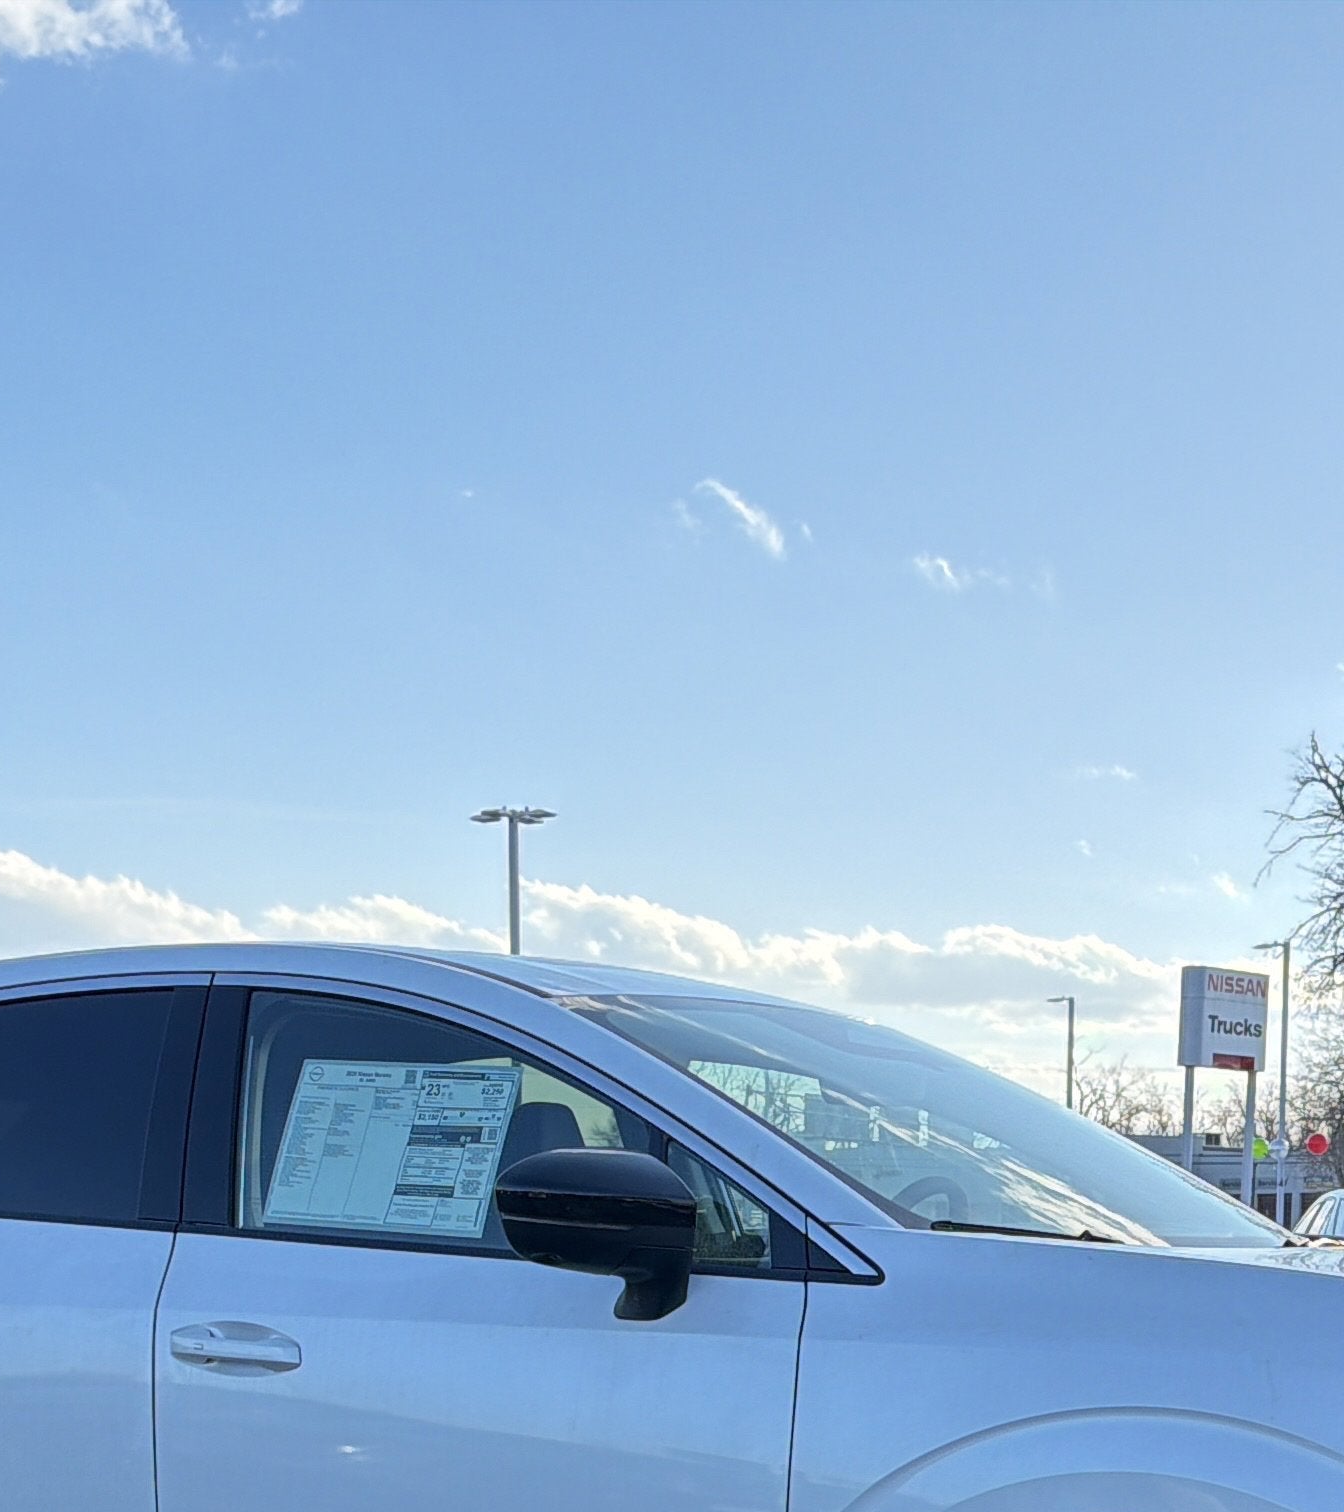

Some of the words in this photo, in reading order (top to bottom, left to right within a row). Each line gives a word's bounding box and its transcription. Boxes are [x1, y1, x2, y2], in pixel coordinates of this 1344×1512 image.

[1207, 973, 1267, 998] NISSAN
[1207, 1014, 1263, 1038] Trucks
[425, 1083, 442, 1097] 23
